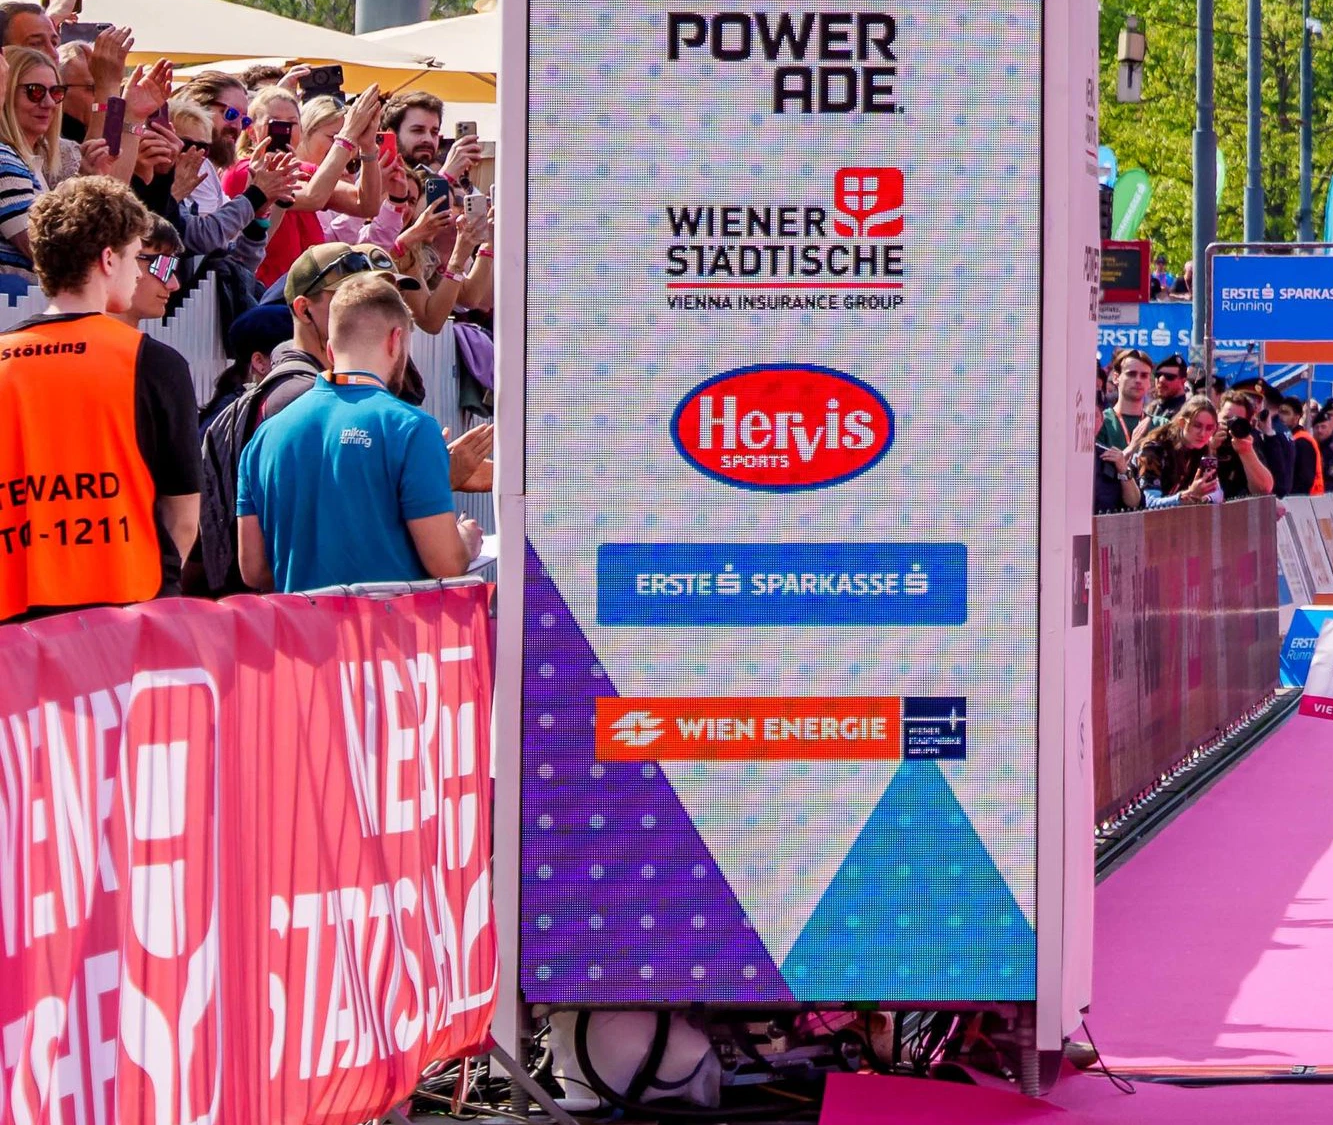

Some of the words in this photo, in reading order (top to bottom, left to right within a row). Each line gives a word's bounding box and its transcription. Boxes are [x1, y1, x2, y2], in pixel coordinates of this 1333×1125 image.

[666, 11, 898, 62] POWER
[665, 206, 827, 238] WIENER
[665, 244, 904, 278] STÄDTISCHE
[666, 295, 733, 311] VIENNA
[737, 295, 839, 311] INSURANCE
[843, 295, 904, 311] GROUP
[1221, 287, 1260, 300] ERSTE
[1221, 300, 1273, 314] Running
[1, 341, 87, 361] Stölting
[698, 395, 877, 462] Hervis
[719, 454, 791, 469] SPORTS
[635, 573, 713, 596] ERSTE
[750, 573, 900, 596] SPARKASSE
[675, 717, 755, 742] WIEN
[763, 717, 887, 742] ENERGIE
